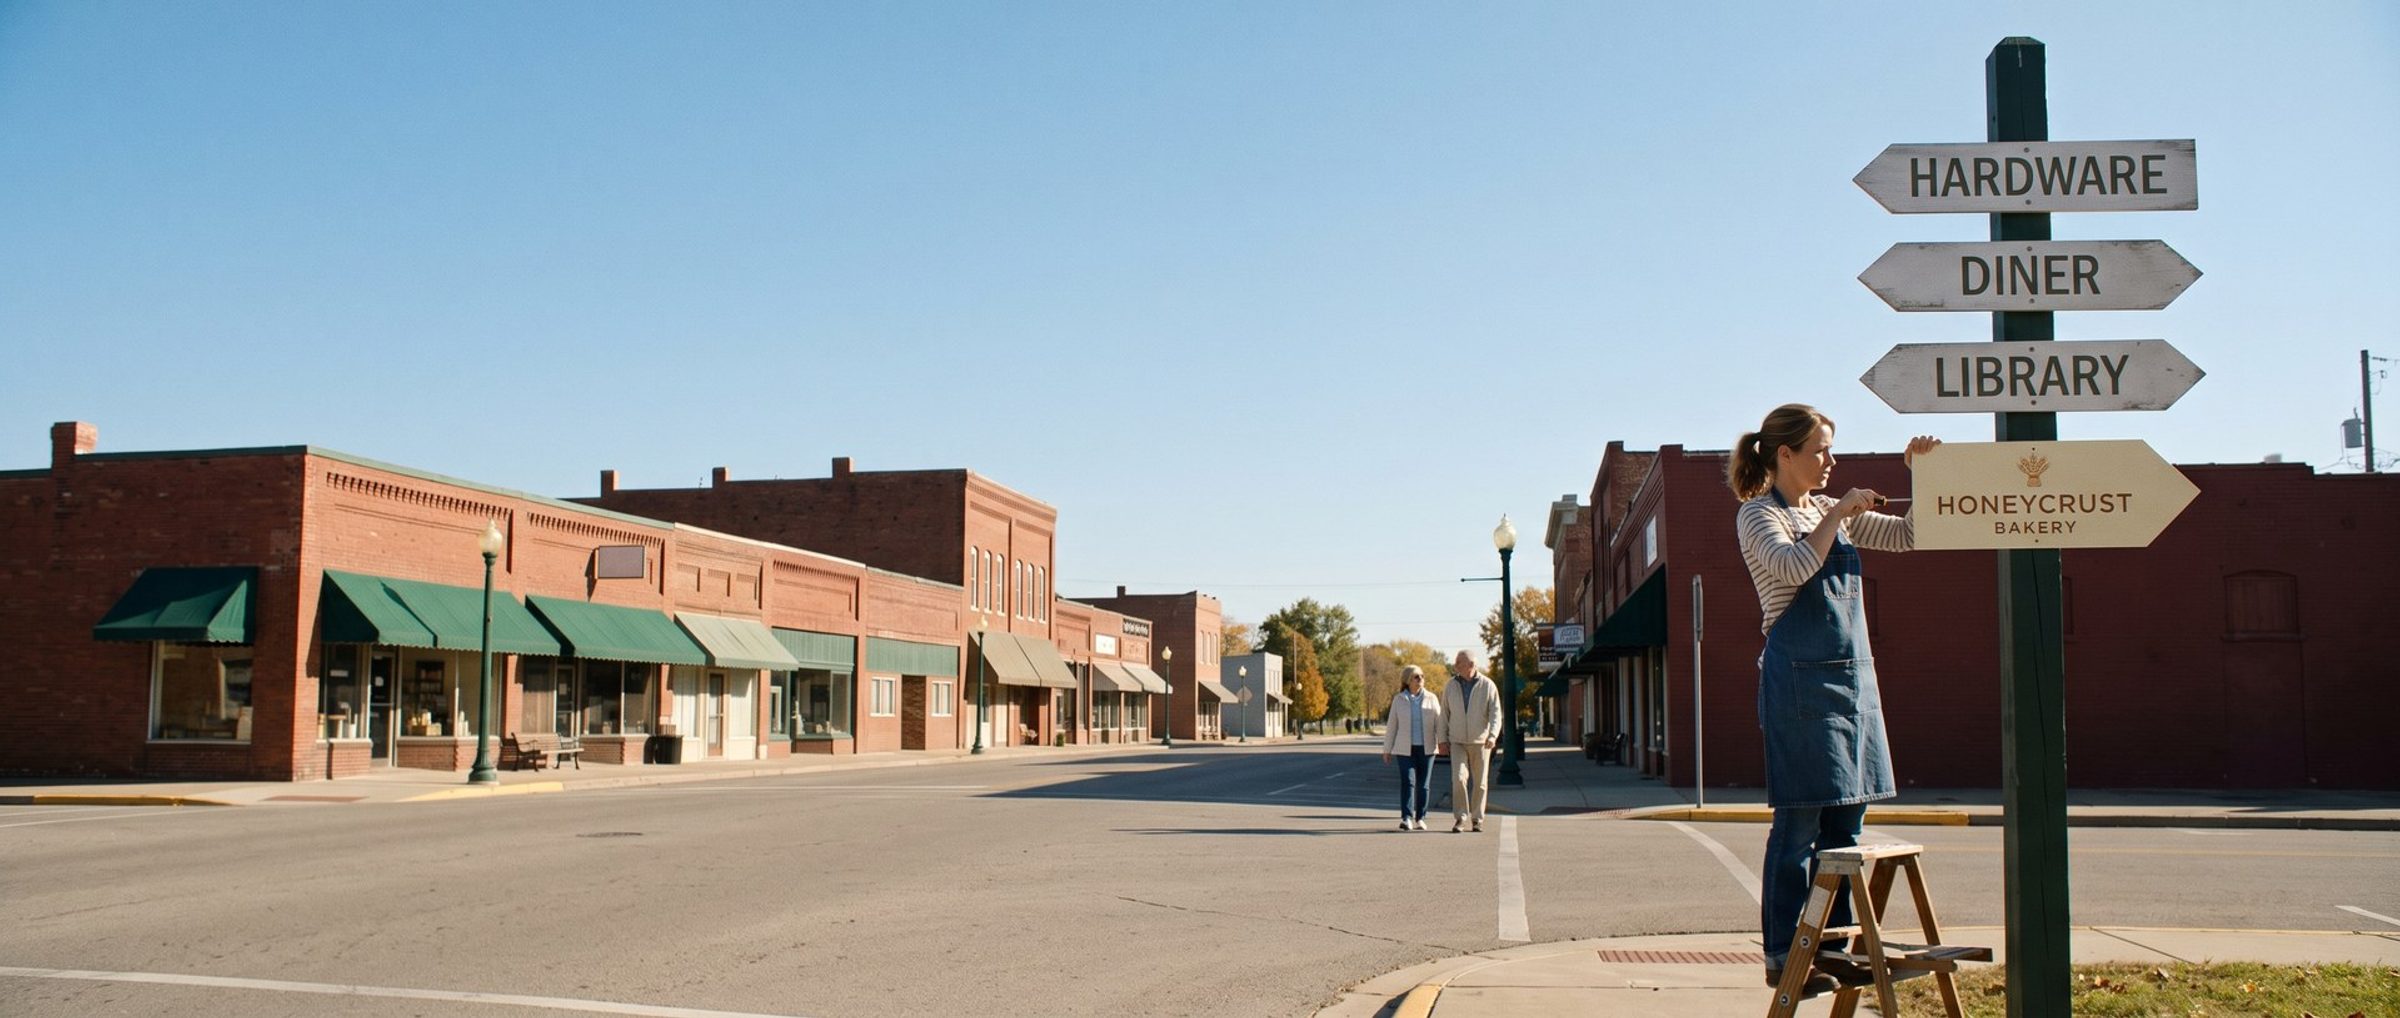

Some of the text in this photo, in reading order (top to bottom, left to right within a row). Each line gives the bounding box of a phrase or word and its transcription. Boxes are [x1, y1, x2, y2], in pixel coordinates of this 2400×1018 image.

[1910, 154, 2168, 198] HARDWARE
[1961, 255, 2101, 296] DINER
[1935, 355, 2130, 397] LIBRARY
[1937, 492, 2133, 516] HONEYCRUST
[1994, 520, 2077, 536] BAKERY
